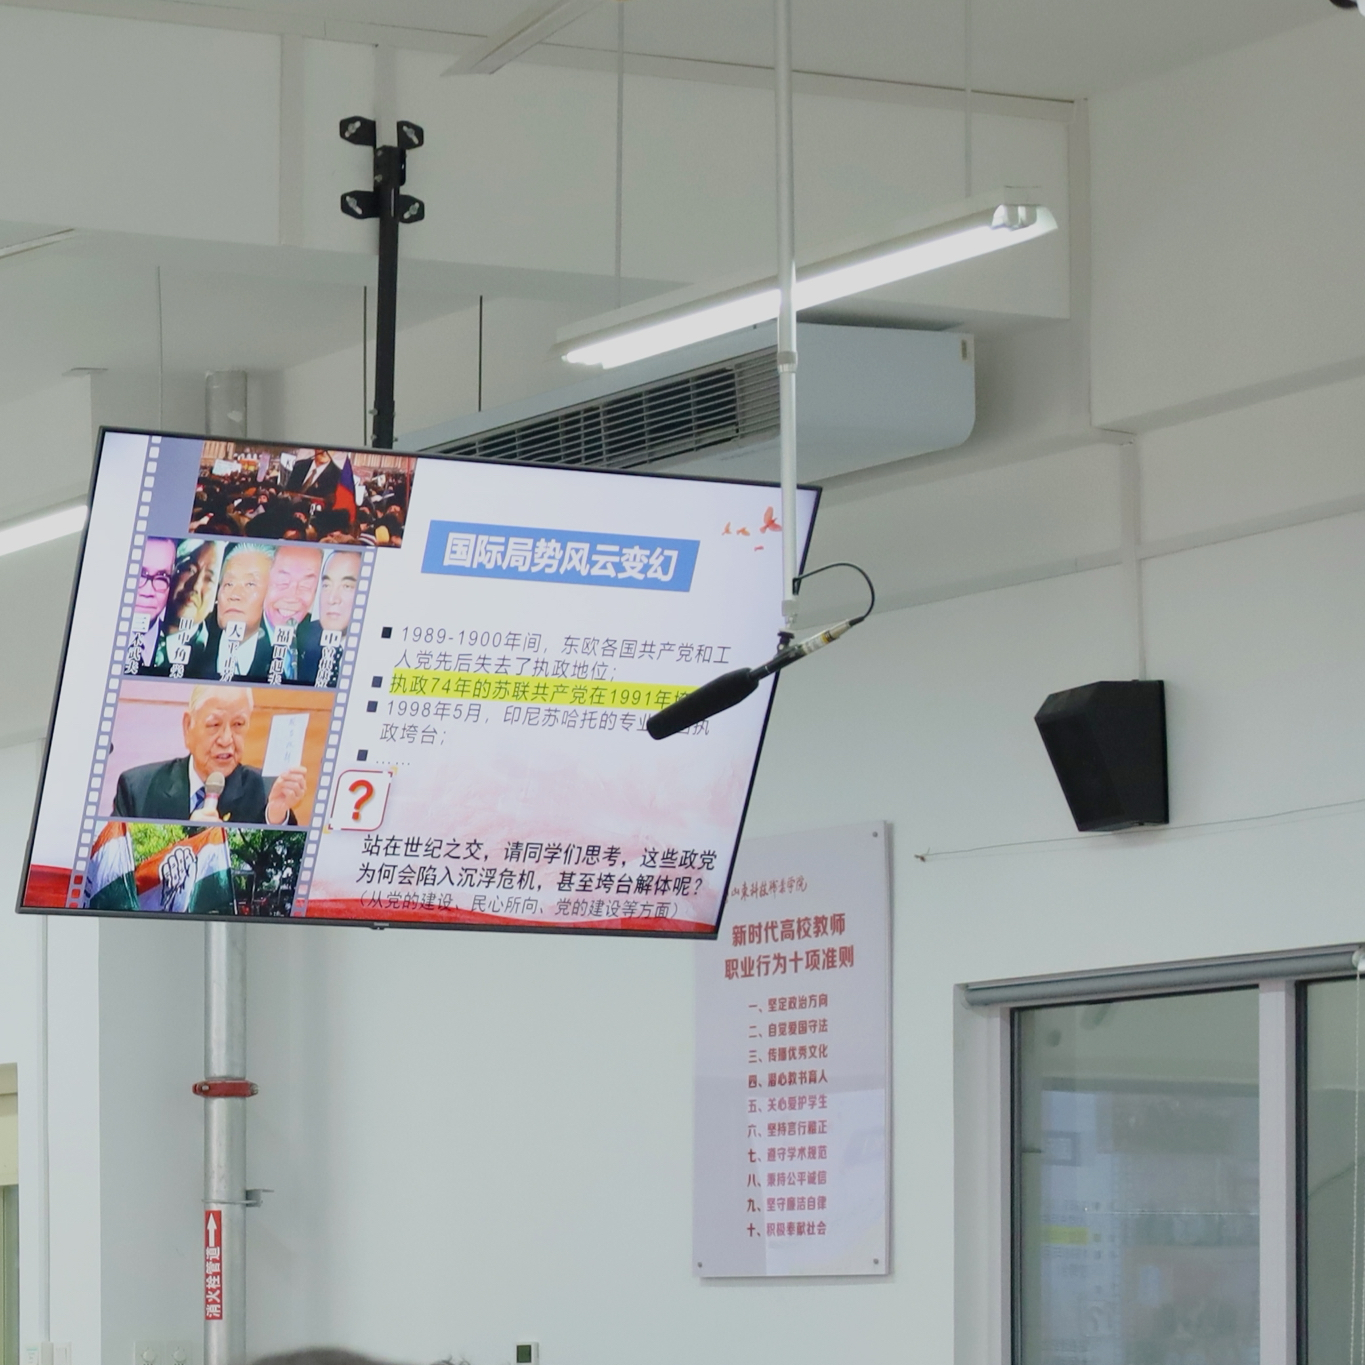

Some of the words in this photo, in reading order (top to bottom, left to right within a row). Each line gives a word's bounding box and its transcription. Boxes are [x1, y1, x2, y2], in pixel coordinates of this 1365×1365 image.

[442, 532, 679, 582] 国际局势风云变幻
[732, 913, 846, 947] 新时代高校教师
[724, 945, 854, 981] 职业行为十项准则
[748, 993, 828, 1013] 一、坚定政治方向
[748, 1018, 828, 1038] 二、自觉爱国守法
[748, 1043, 828, 1063] 三、传播优秀文化
[748, 1069, 828, 1089] 四、潜心教书育人
[748, 1094, 828, 1113] 五、关心爱护学生
[747, 1120, 828, 1138] 六、坚持言行雅正
[747, 1145, 827, 1163] 七、遵守学术规范
[747, 1170, 827, 1188] 八、秉持公平诚信
[747, 1195, 827, 1213] 九、坚守廉洁自律
[746, 1220, 827, 1238] 十、积极奉献社会
[205, 1246, 221, 1318] 消火栓管道
